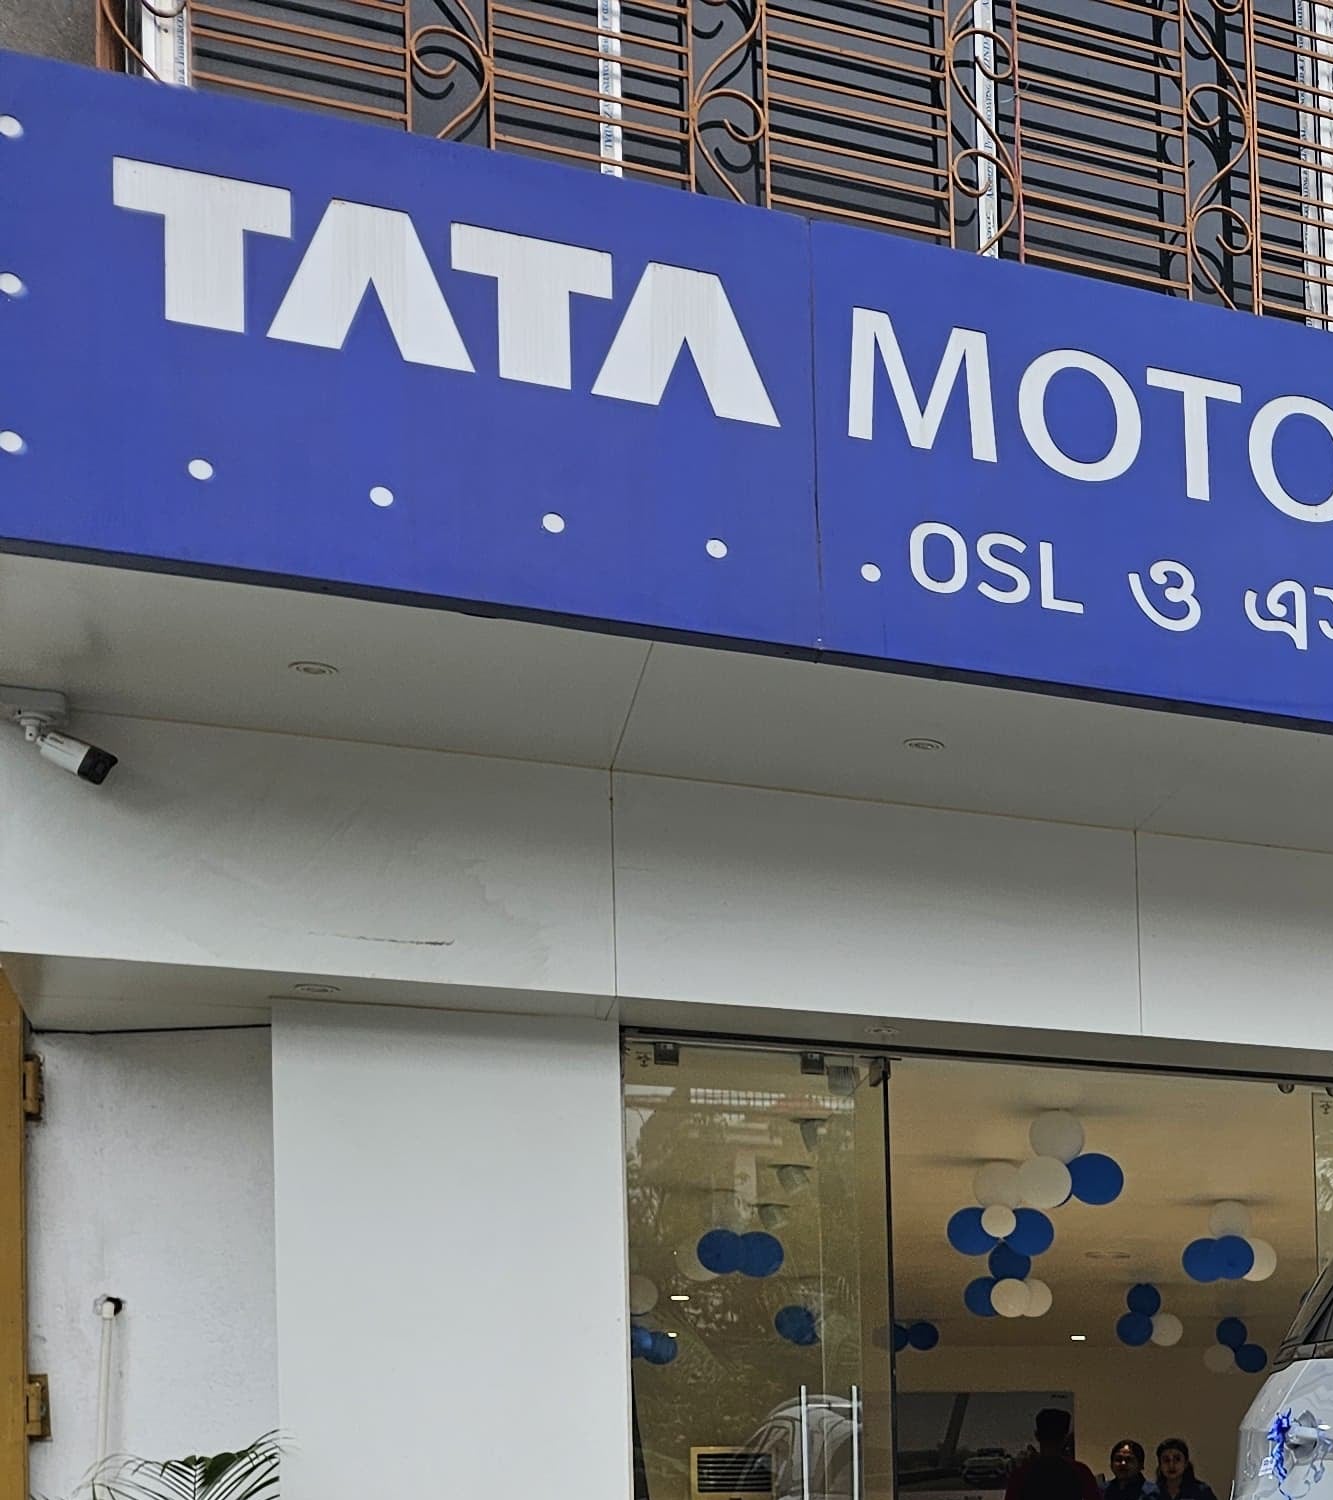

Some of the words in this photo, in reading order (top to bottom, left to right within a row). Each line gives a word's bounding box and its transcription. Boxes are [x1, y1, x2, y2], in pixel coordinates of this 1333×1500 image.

[112, 156, 781, 428] TATA
[908, 521, 1084, 614] OSL
[1128, 559, 1202, 632] ও
